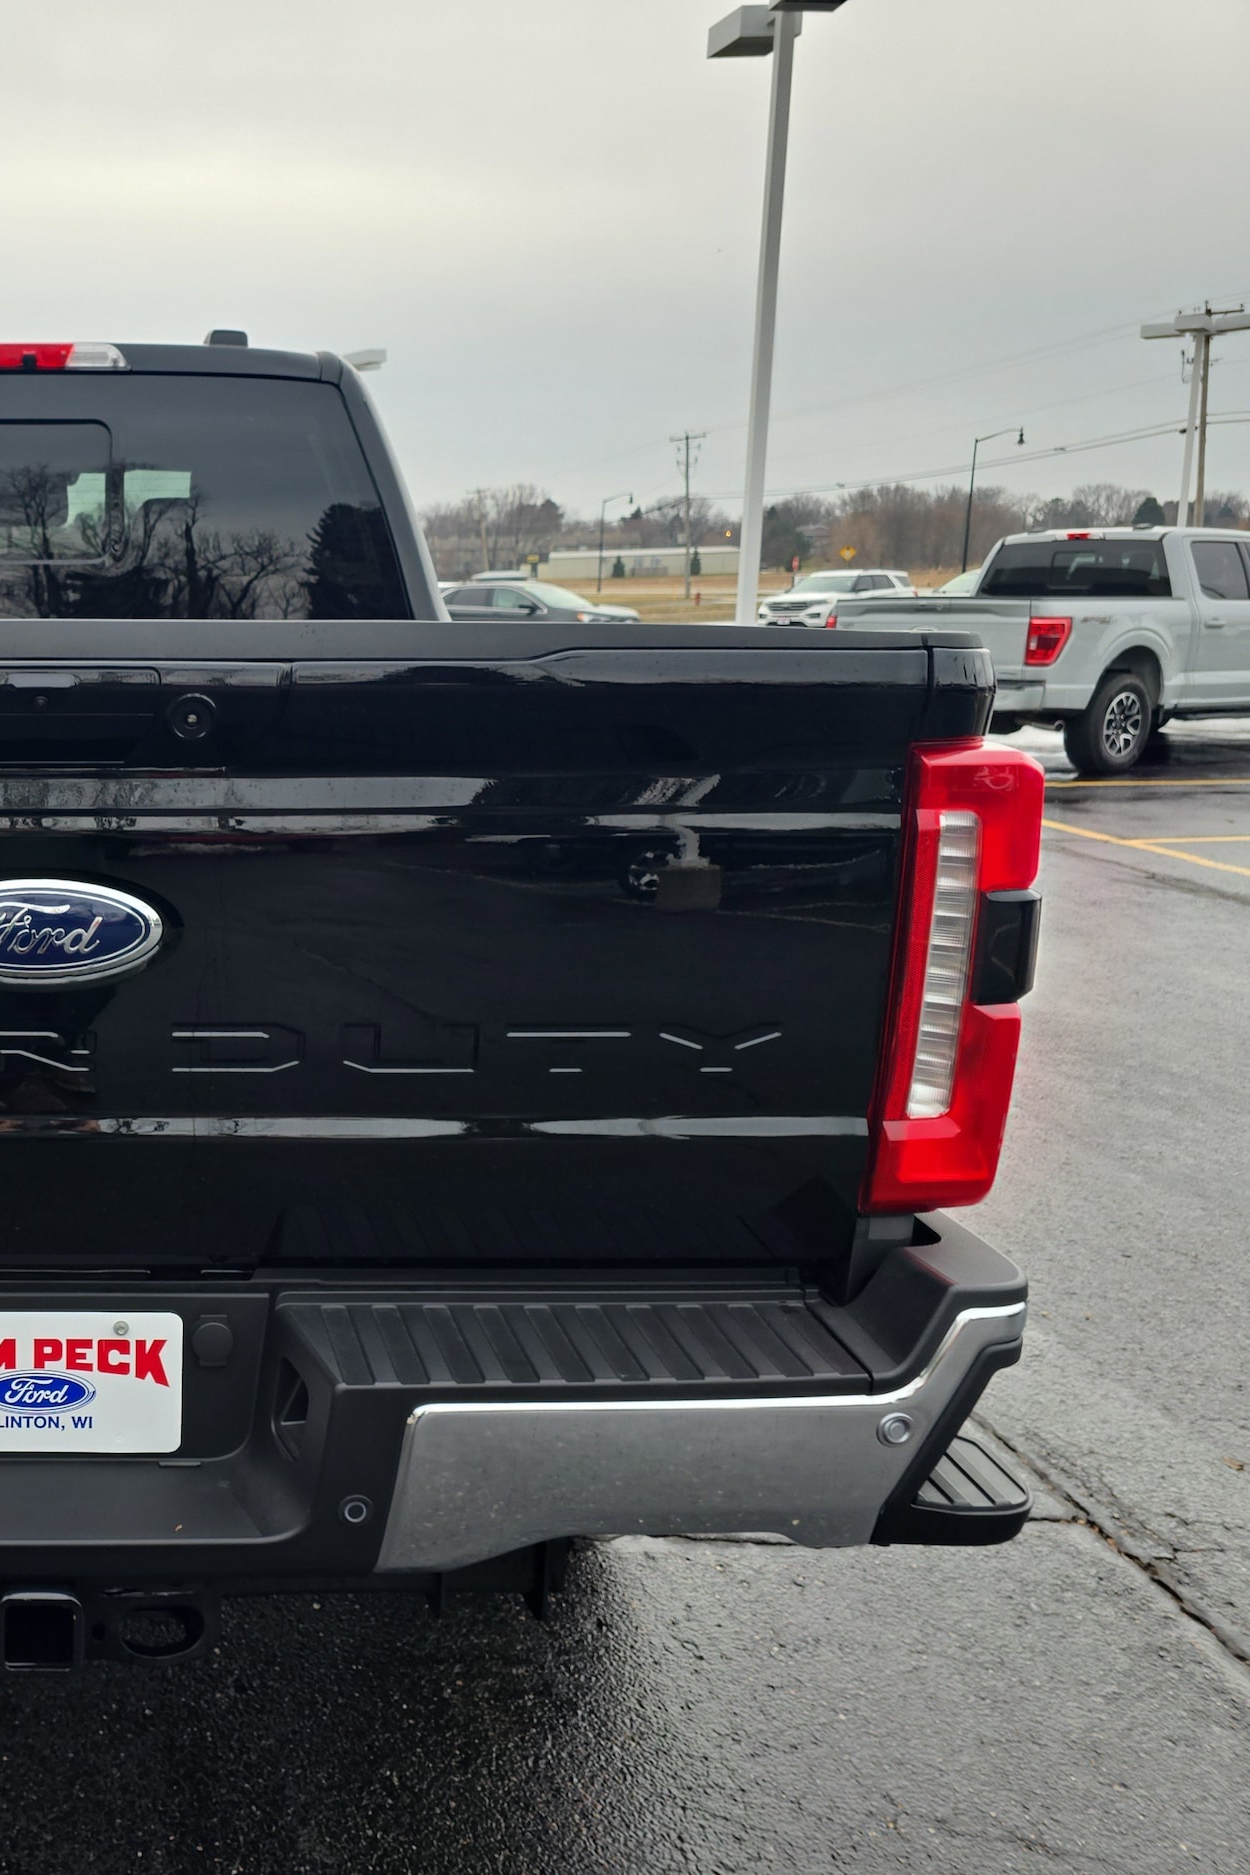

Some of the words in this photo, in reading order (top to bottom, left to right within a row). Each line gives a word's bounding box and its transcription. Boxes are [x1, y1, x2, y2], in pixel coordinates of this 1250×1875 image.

[170, 1022, 785, 1075] DUTY
[33, 1338, 170, 1388] PECK
[4, 1377, 69, 1404] Ford
[71, 1416, 93, 1430] WI
